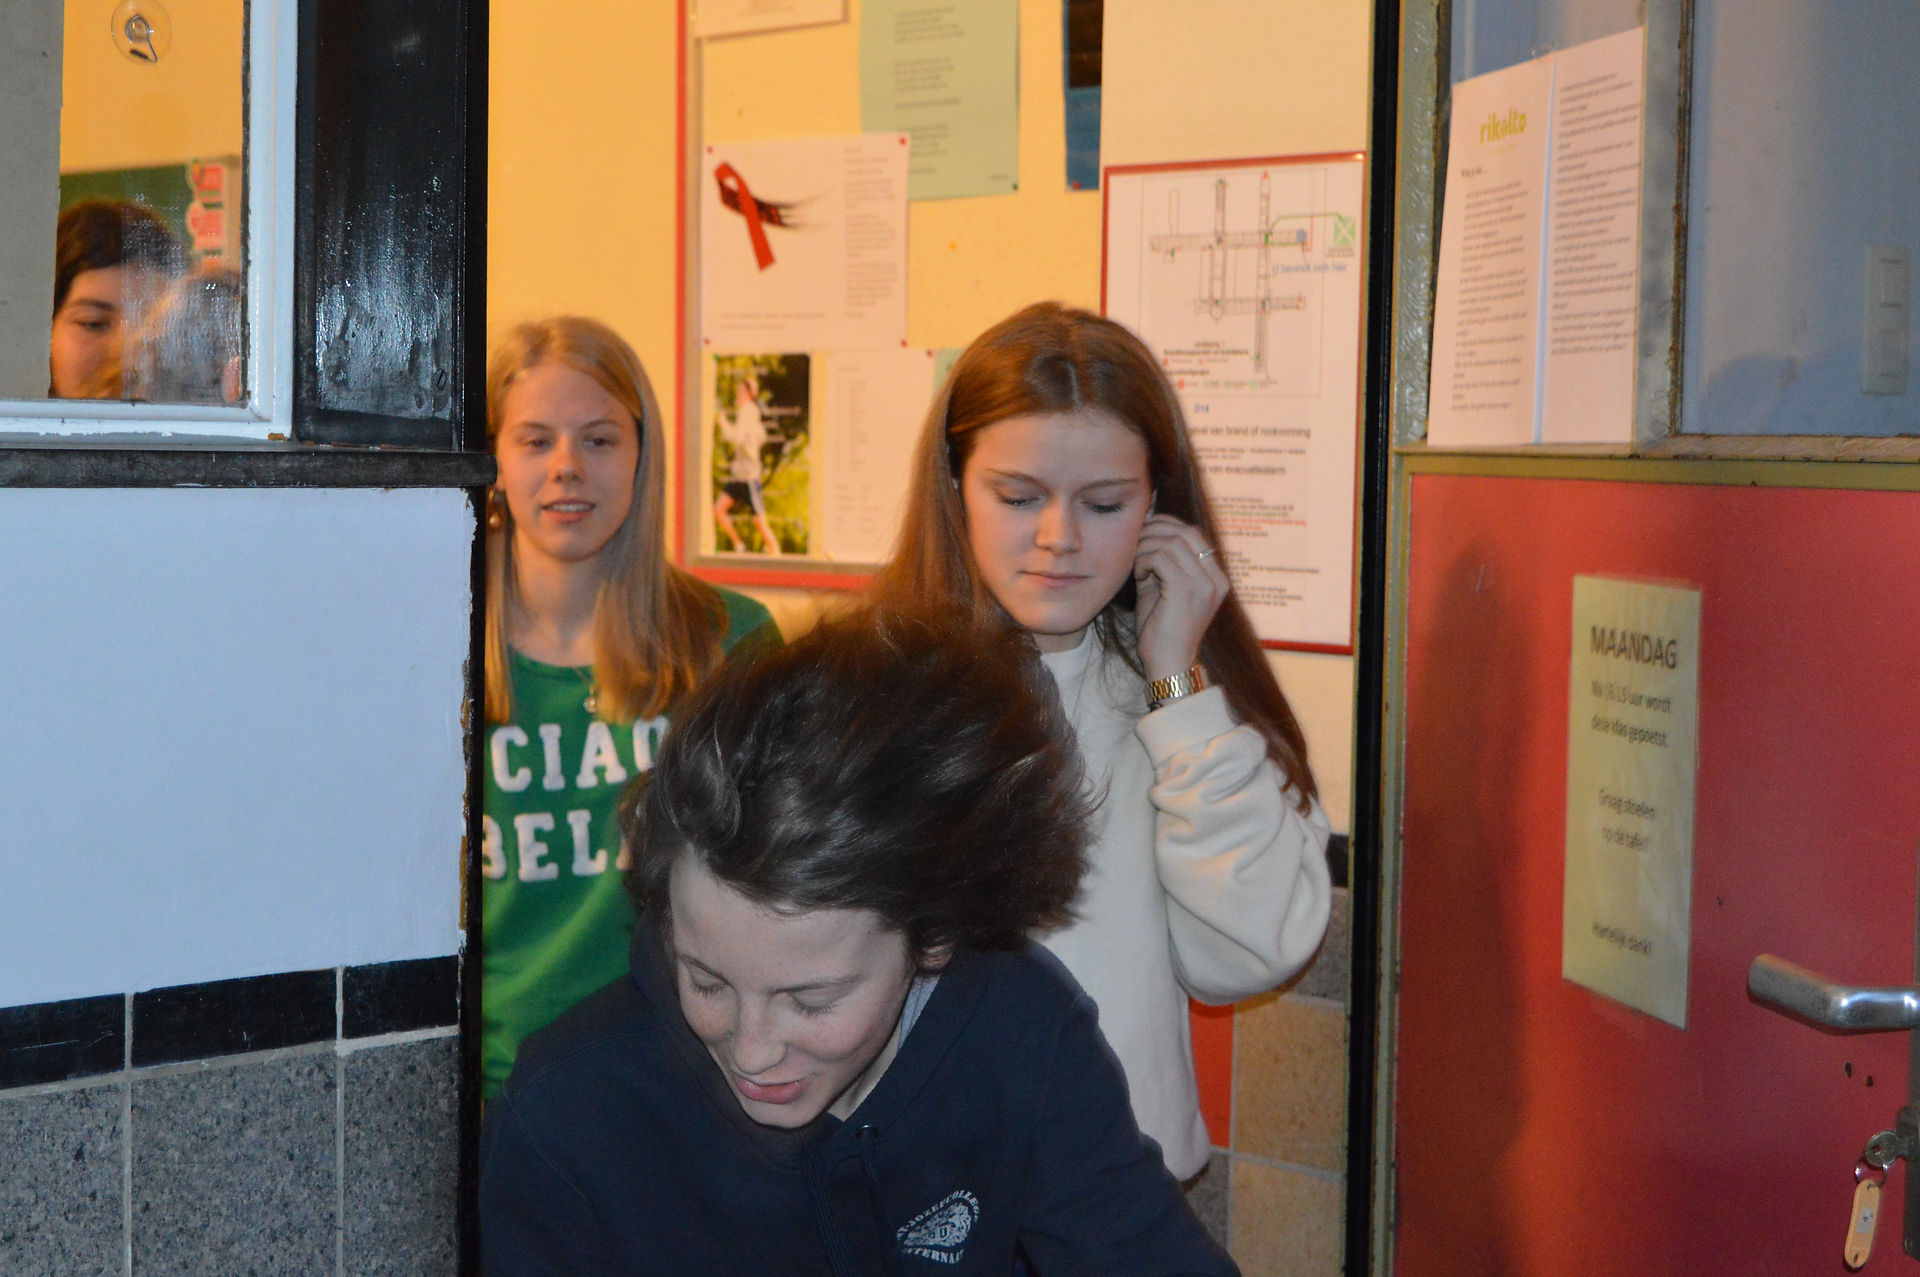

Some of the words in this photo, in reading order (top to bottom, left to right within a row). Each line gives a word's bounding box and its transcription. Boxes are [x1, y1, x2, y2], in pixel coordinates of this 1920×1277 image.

[1480, 107, 1527, 144] rikolto
[1590, 625, 1678, 670] MAANDAG
[1645, 694, 1672, 714] wordt
[491, 715, 670, 793] CIAO
